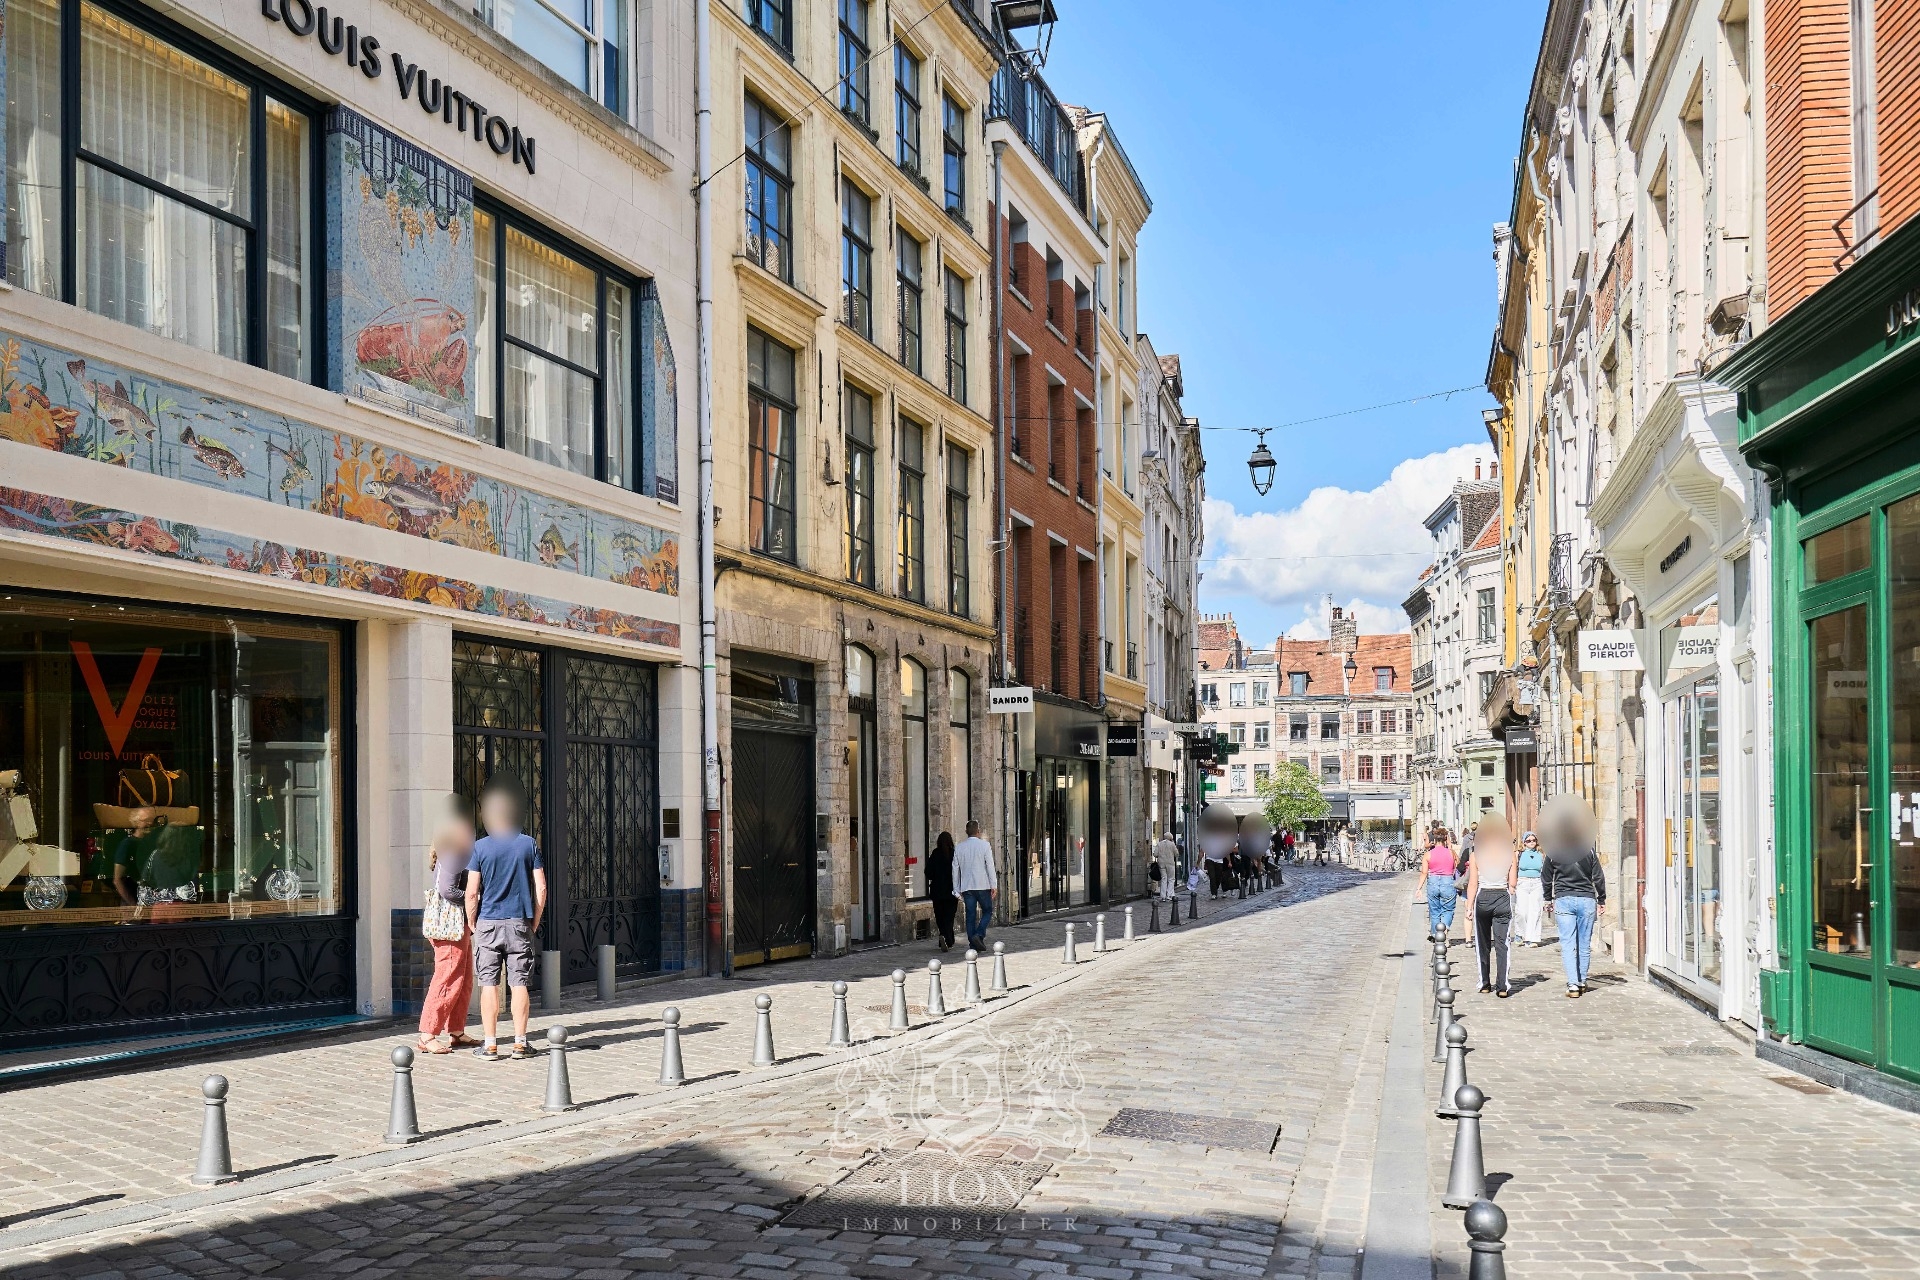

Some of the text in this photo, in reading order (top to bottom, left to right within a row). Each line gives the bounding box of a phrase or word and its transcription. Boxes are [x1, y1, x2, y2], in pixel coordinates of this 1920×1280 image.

[391, 52, 536, 175] VUITTON
[1588, 642, 1636, 651] CLAUDIE
[1590, 650, 1635, 659] PIERLOT
[992, 696, 1029, 704] SANDRO
[79, 751, 110, 761] LOUIS
